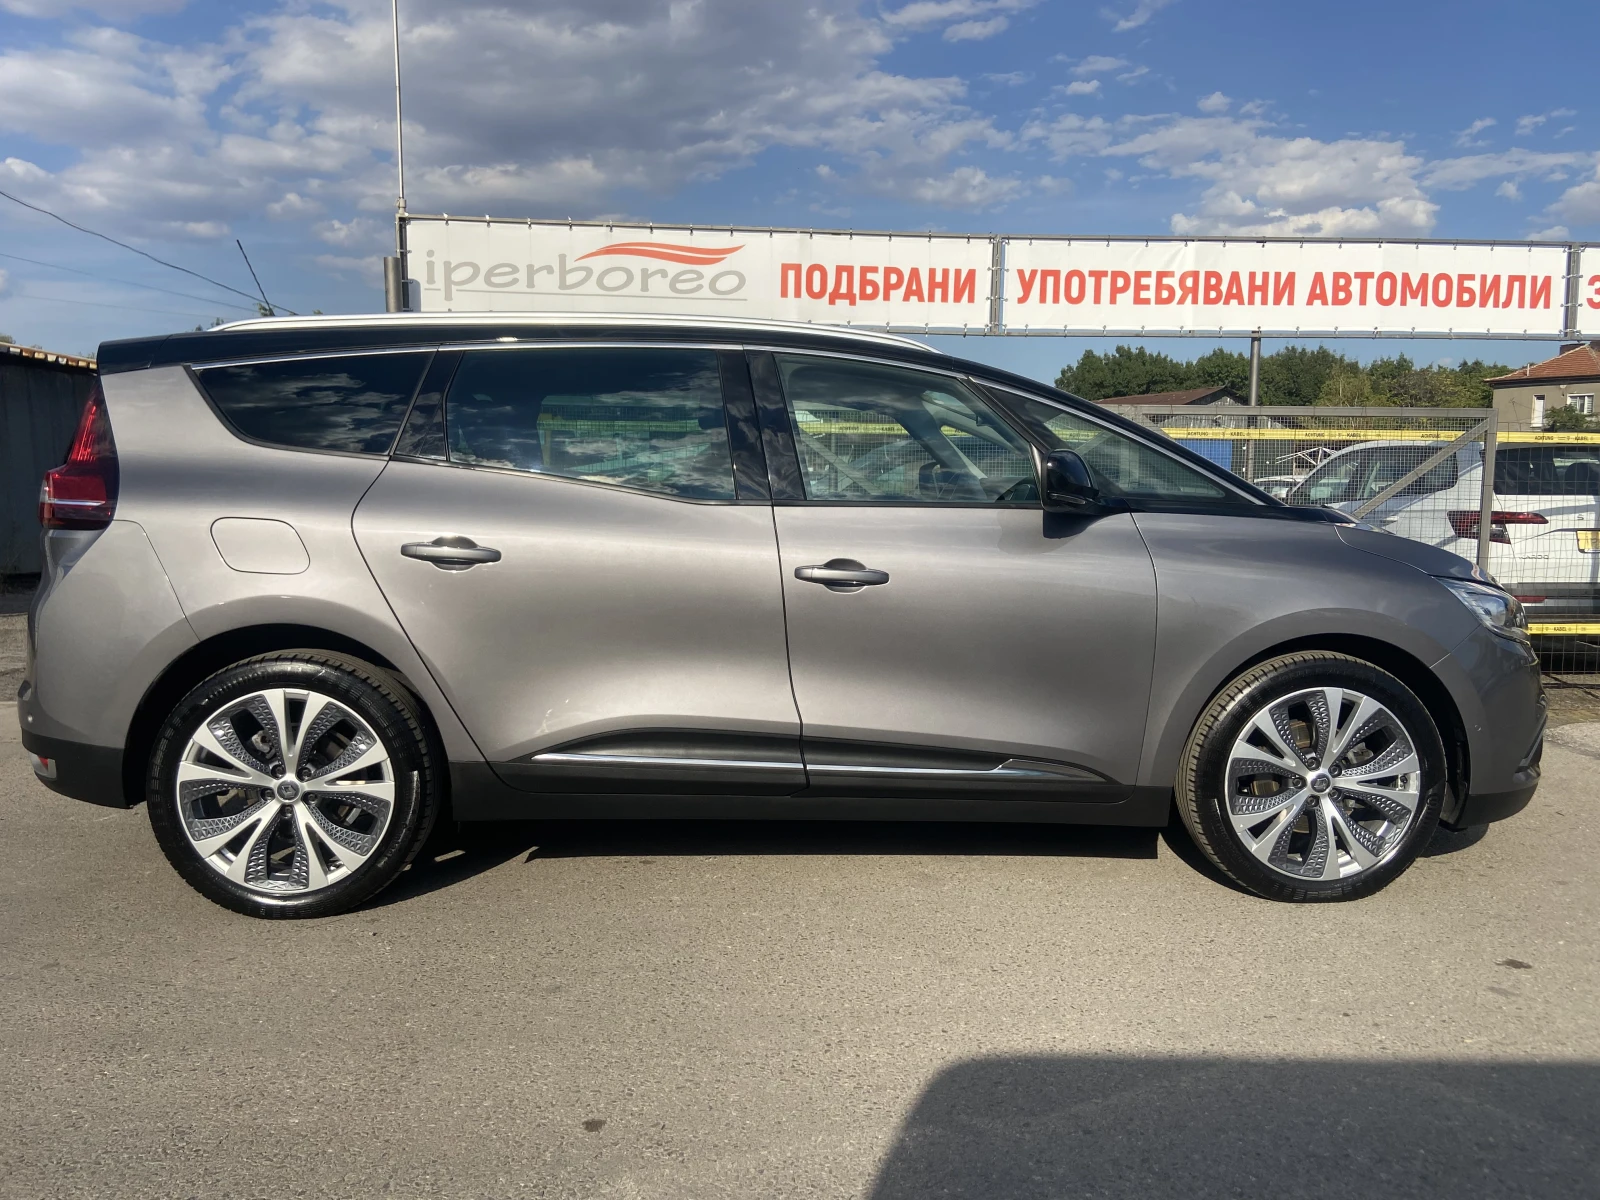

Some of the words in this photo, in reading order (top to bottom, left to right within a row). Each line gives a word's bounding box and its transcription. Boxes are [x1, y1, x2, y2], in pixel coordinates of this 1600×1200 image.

[426, 250, 746, 301] iperboreo
[780, 263, 976, 306] ПОДБРАНИ
[1017, 269, 1295, 306] УПОТРЕБЯВАНИ
[1306, 271, 1551, 308] АВТОМОБИЛИ
